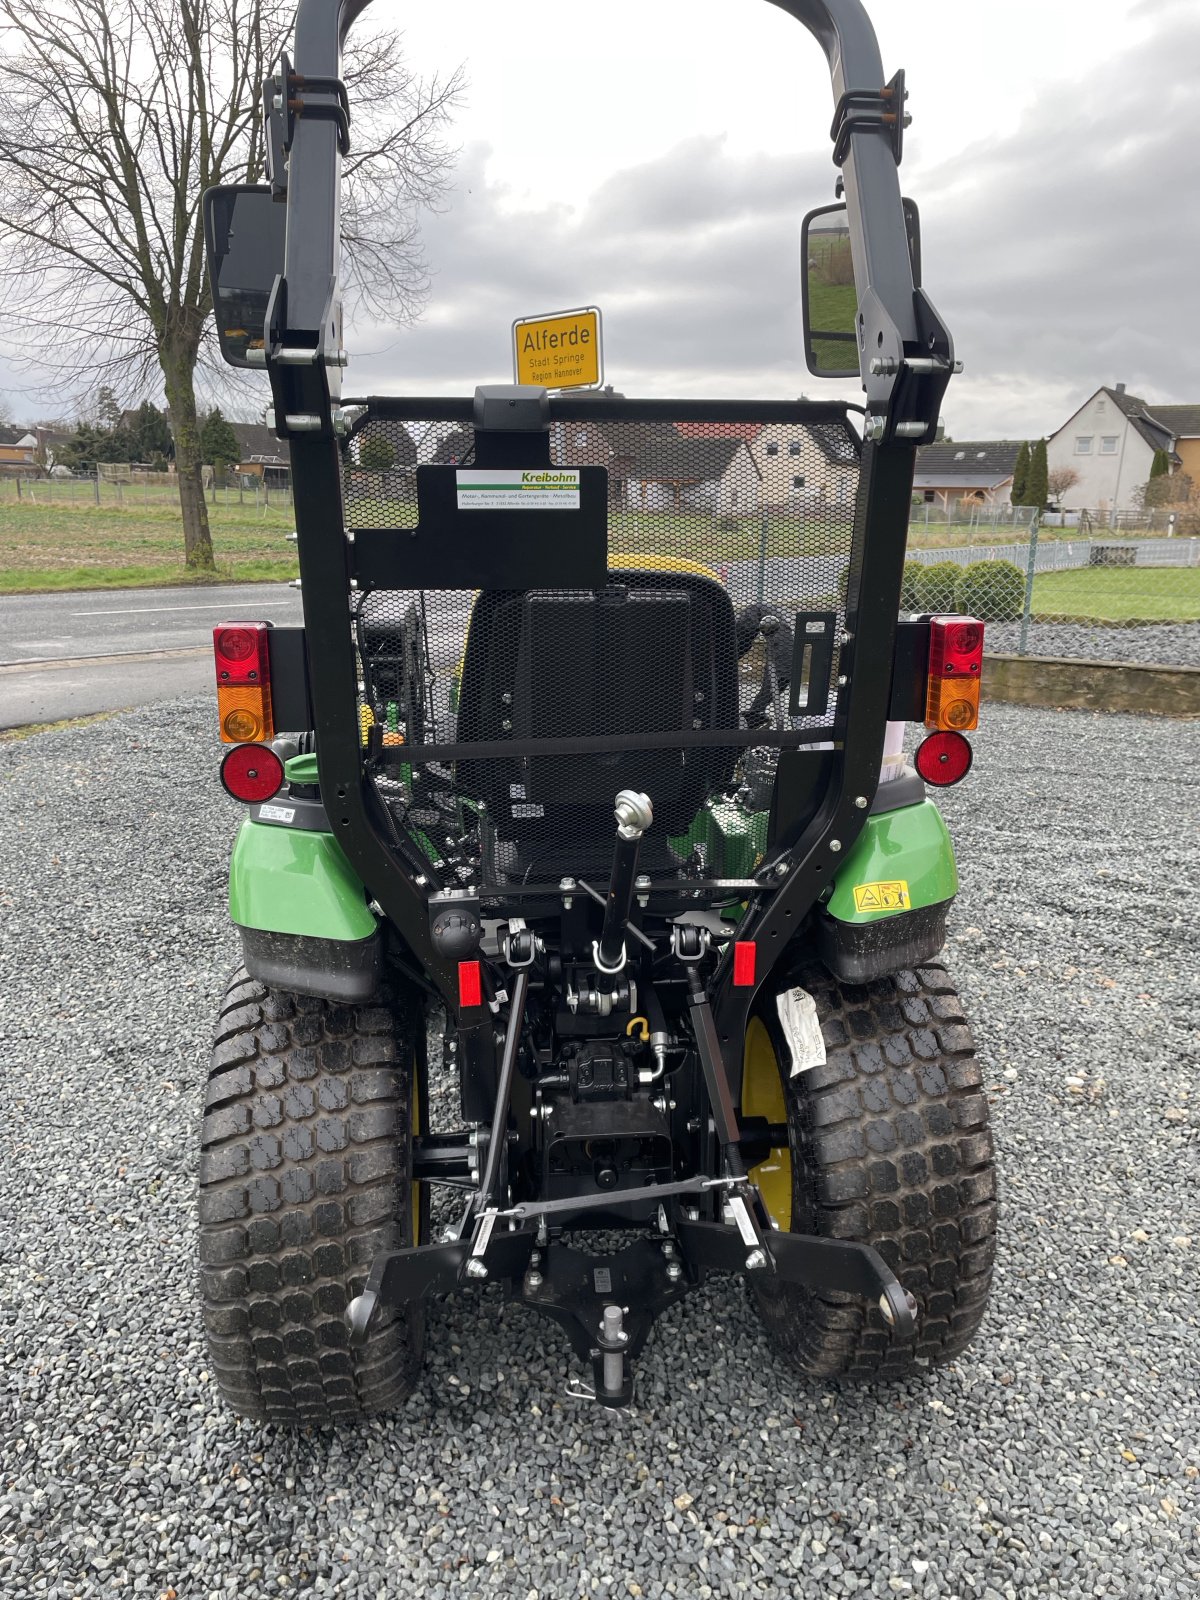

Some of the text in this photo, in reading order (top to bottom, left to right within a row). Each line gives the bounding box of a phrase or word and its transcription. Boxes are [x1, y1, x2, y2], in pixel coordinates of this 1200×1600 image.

[523, 324, 590, 352] Alferde
[529, 353, 585, 368] Stadt Springe
[532, 367, 582, 382] Region Hannover
[521, 473, 577, 482] Kreibohm
